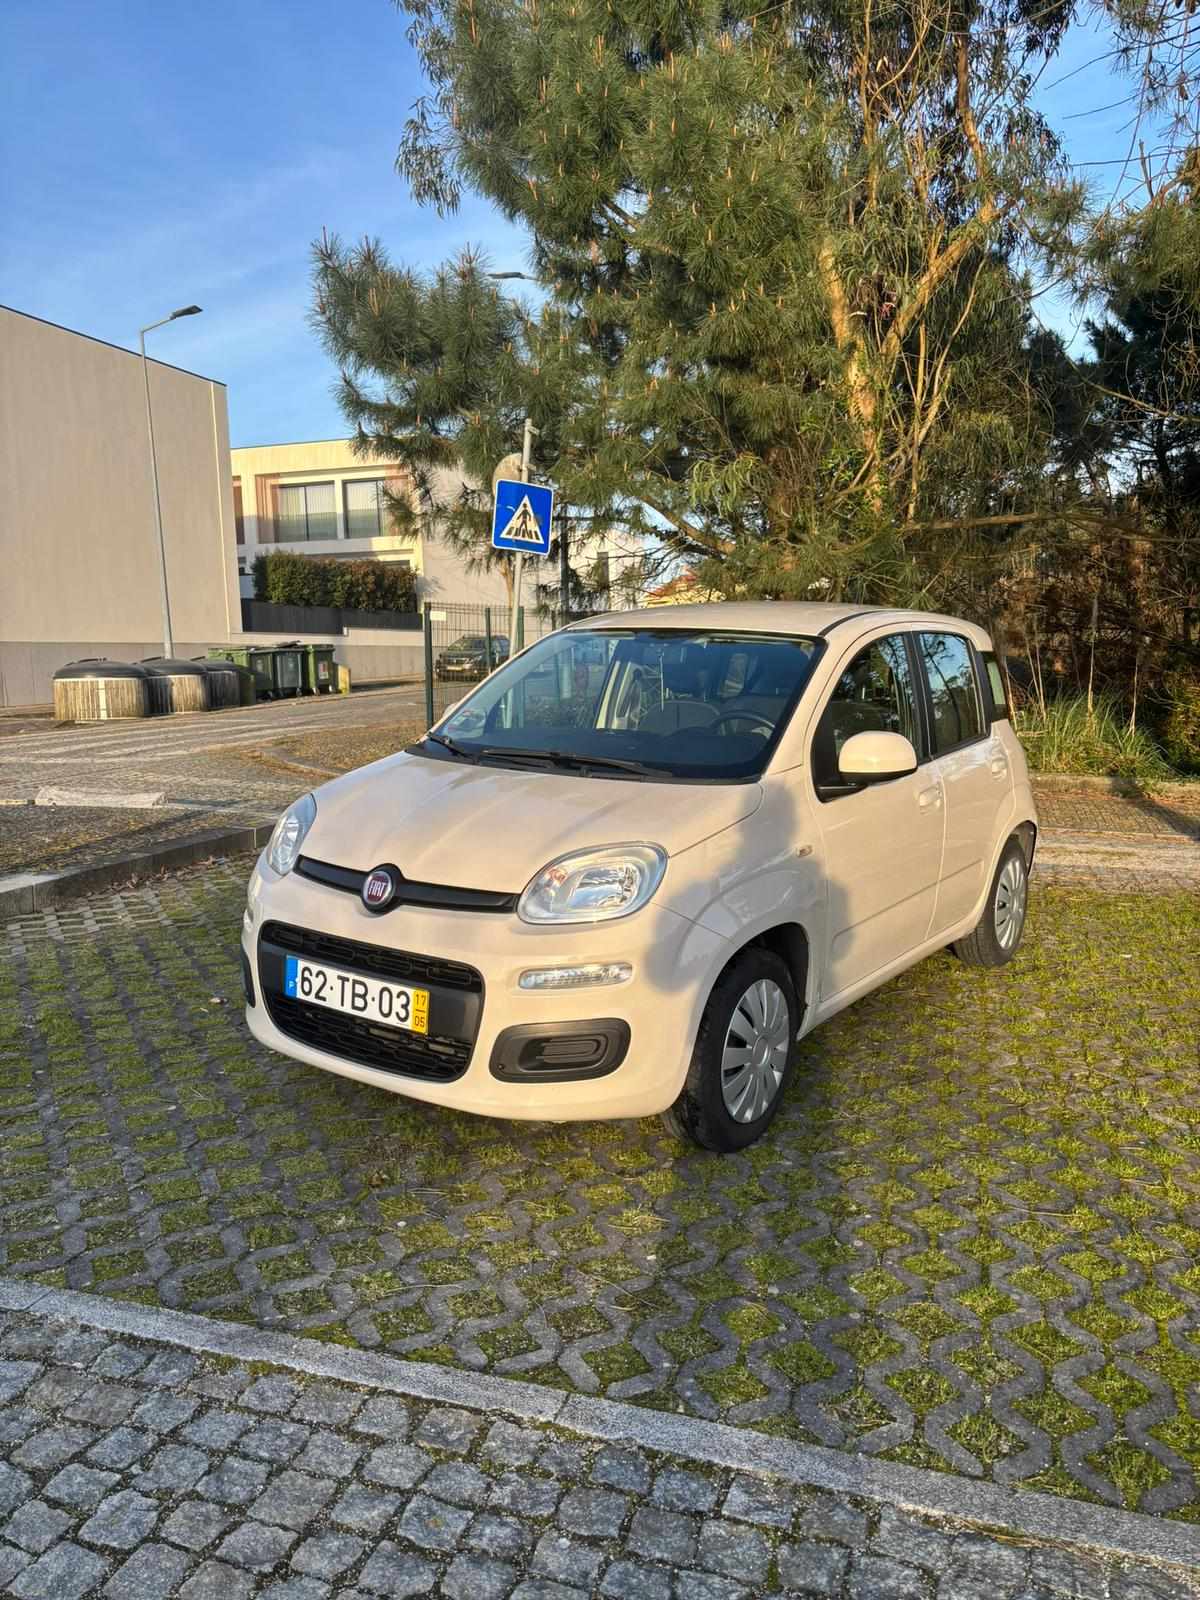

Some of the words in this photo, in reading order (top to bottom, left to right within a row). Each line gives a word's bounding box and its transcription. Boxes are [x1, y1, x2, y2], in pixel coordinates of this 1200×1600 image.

[368, 879, 387, 897] FIAT
[414, 994, 426, 1007] 17
[414, 1015, 425, 1028] 05
